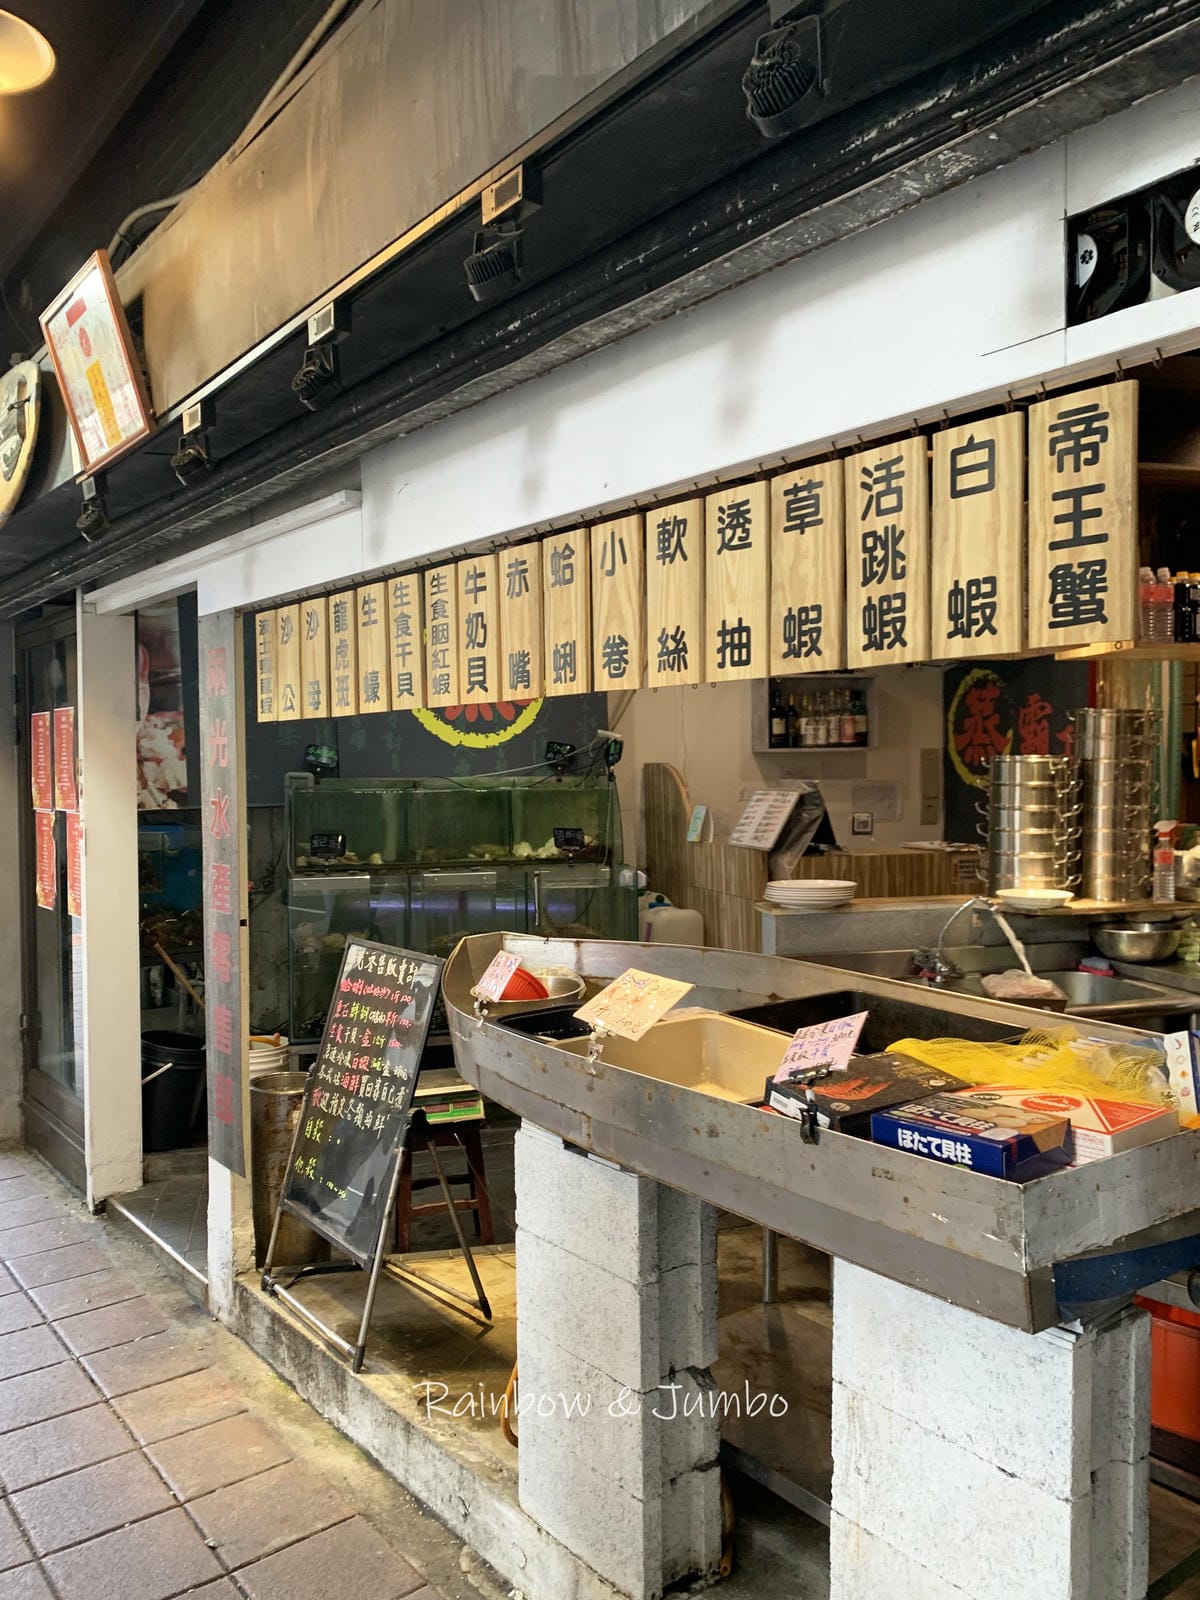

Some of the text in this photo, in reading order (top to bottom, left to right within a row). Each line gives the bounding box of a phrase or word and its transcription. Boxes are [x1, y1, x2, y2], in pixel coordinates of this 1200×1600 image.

[716, 498, 753, 669] 透抽
[782, 479, 824, 659] 草蝦
[860, 454, 908, 652] 活跳蝦
[946, 434, 998, 640] 白蝦
[1048, 403, 1110, 630] 帝王蟹
[361, 594, 381, 704] 生蠔
[393, 580, 415, 699] 生食干貝
[429, 572, 451, 696] 生食胭紅蝦
[465, 565, 489, 695] 牛奶貝
[506, 557, 531, 691] 赤嘴
[550, 543, 577, 685] 蛤蜊
[600, 528, 629, 679] 小卷
[656, 514, 689, 673] 軟絲
[280, 614, 296, 713] 沙公
[897, 1127, 973, 1165] ほたて貝柱
[898, 1103, 997, 1131] ほたて貝柱
